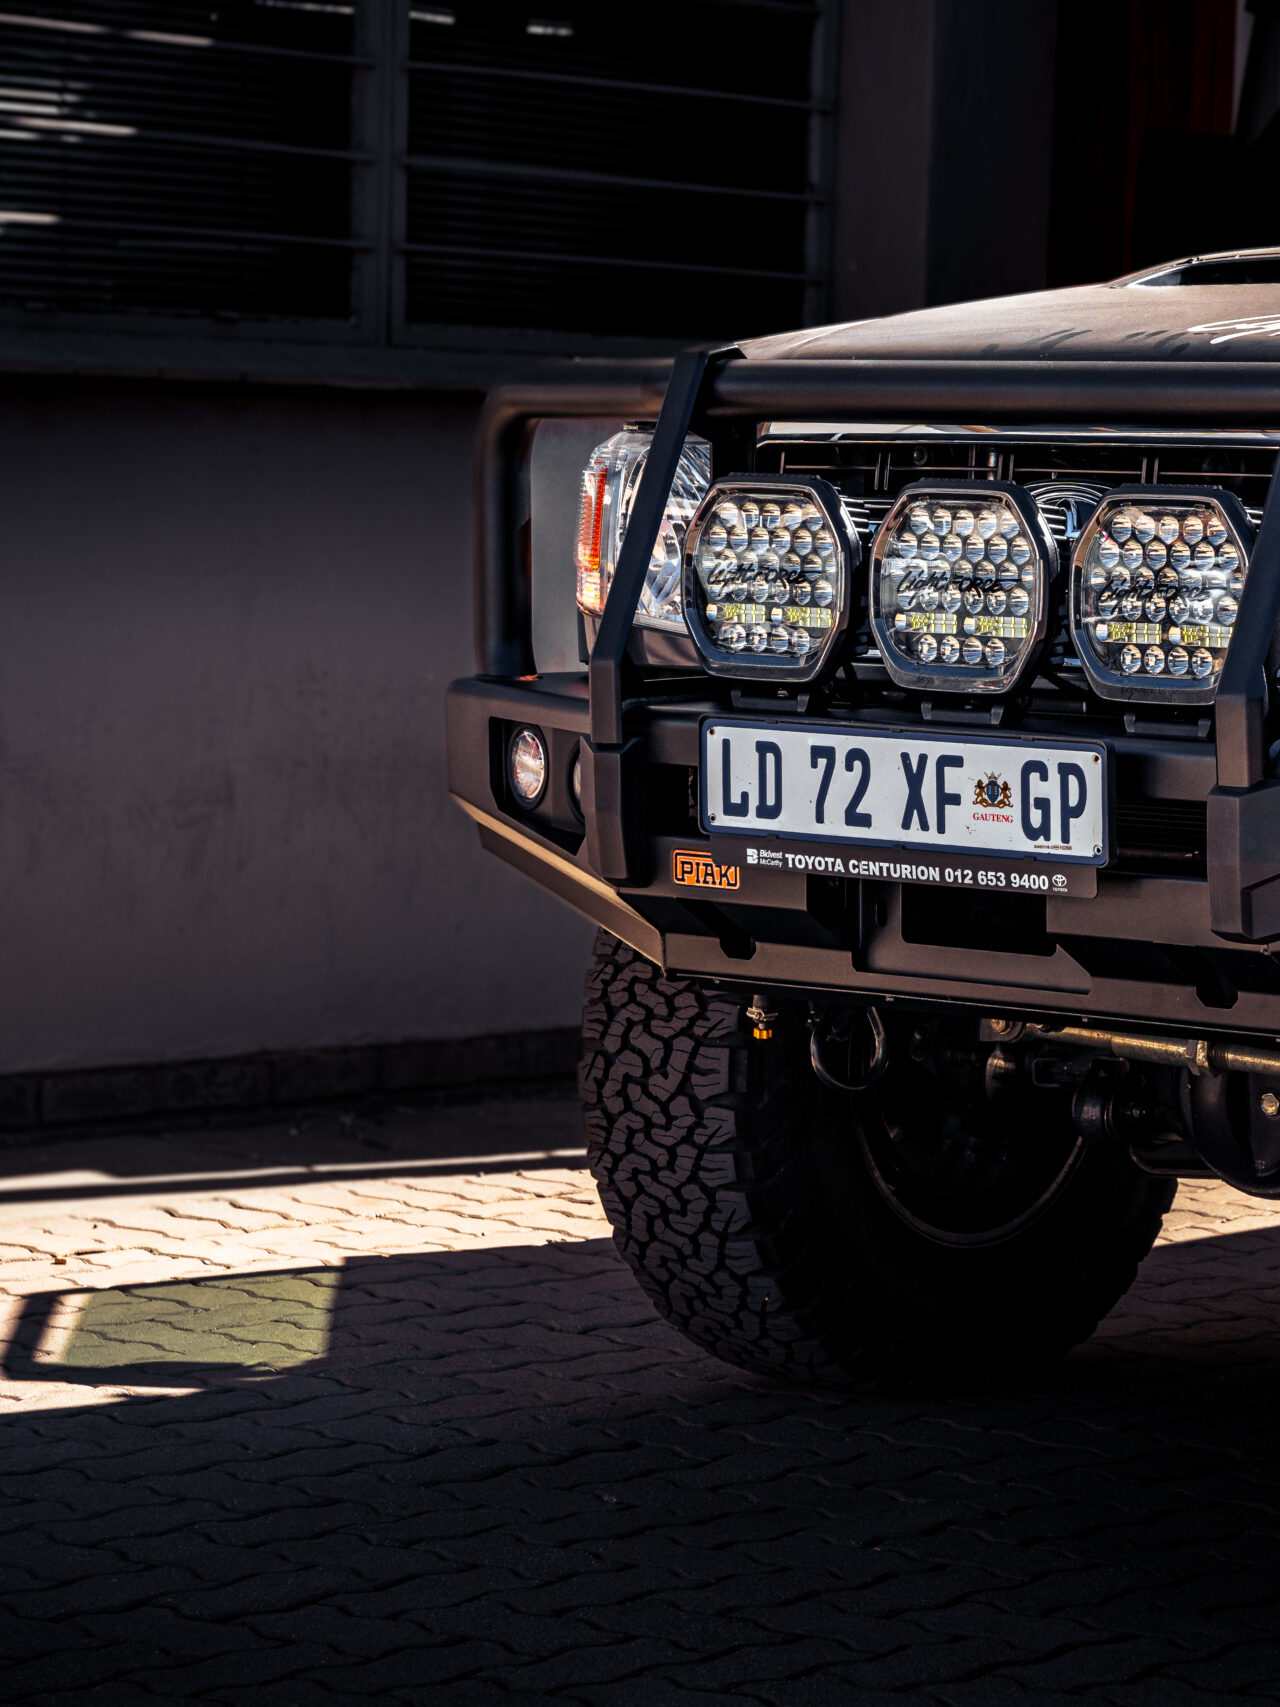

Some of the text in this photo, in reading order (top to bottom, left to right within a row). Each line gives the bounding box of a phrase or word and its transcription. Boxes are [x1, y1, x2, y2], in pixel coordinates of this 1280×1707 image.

[721, 738, 1088, 844] LD 72 XF GP
[972, 811, 1014, 824] GAUTENG
[759, 849, 783, 859] Bidvest
[759, 858, 783, 869] McCarthy
[677, 858, 738, 888] PIAK
[785, 852, 1049, 890] TOYOTA CENTURION 012 653 9400
